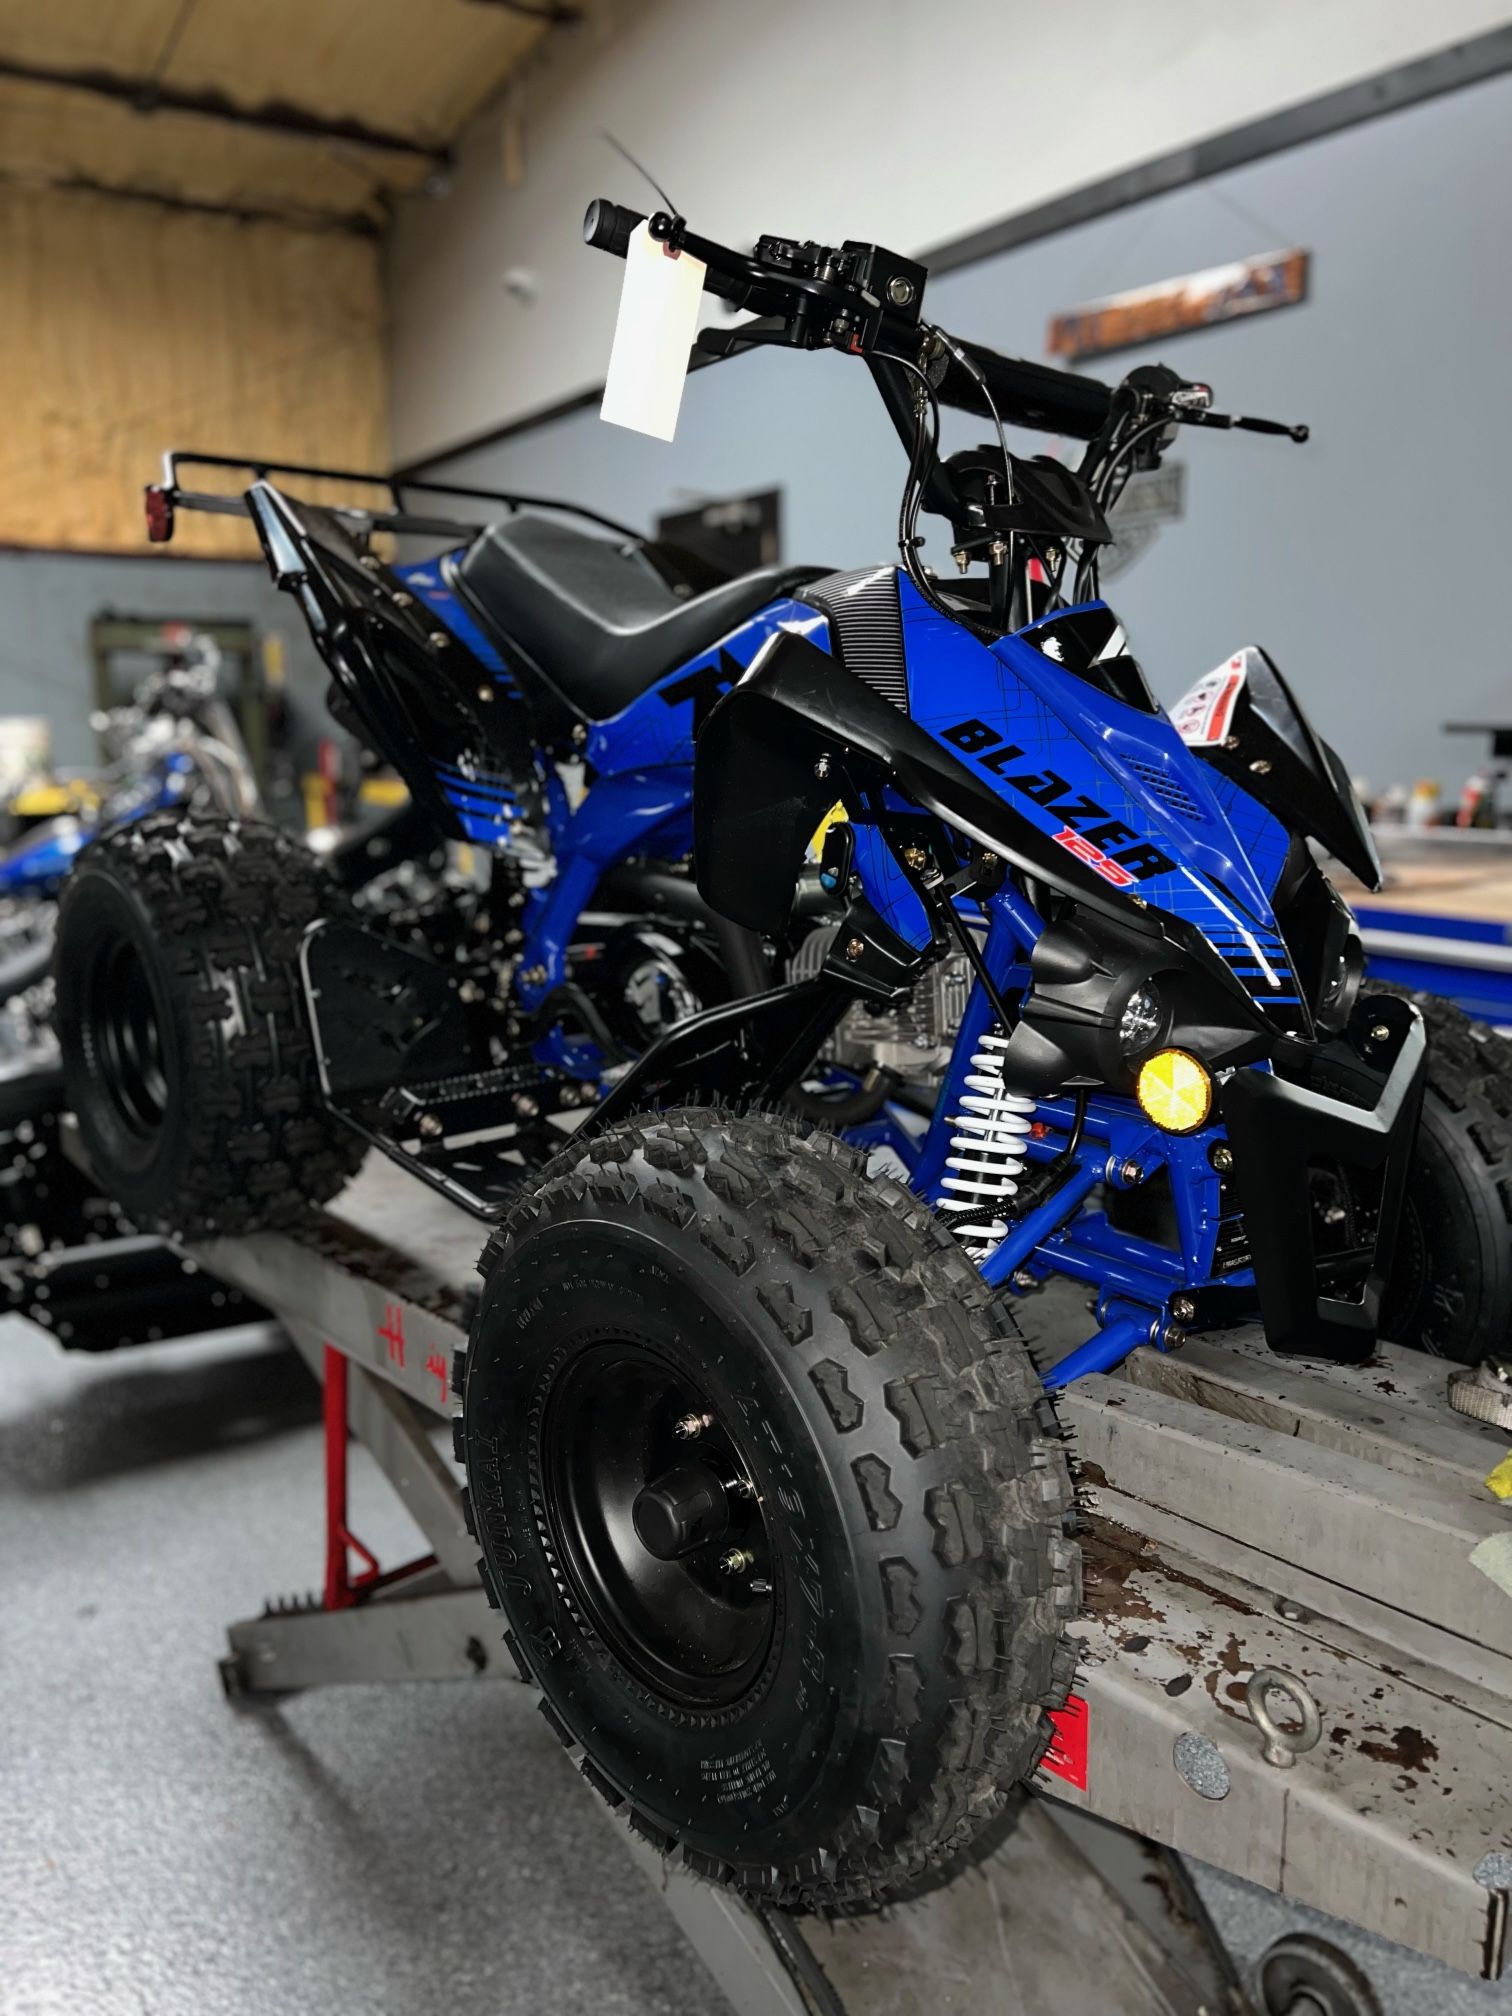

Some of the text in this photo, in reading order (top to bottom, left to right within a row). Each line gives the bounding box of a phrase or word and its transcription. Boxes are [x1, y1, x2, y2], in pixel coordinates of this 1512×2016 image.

[939, 718, 1178, 881] BLAZER
[1051, 825, 1140, 887] 125
[473, 1428, 533, 1597] JUNKAI
